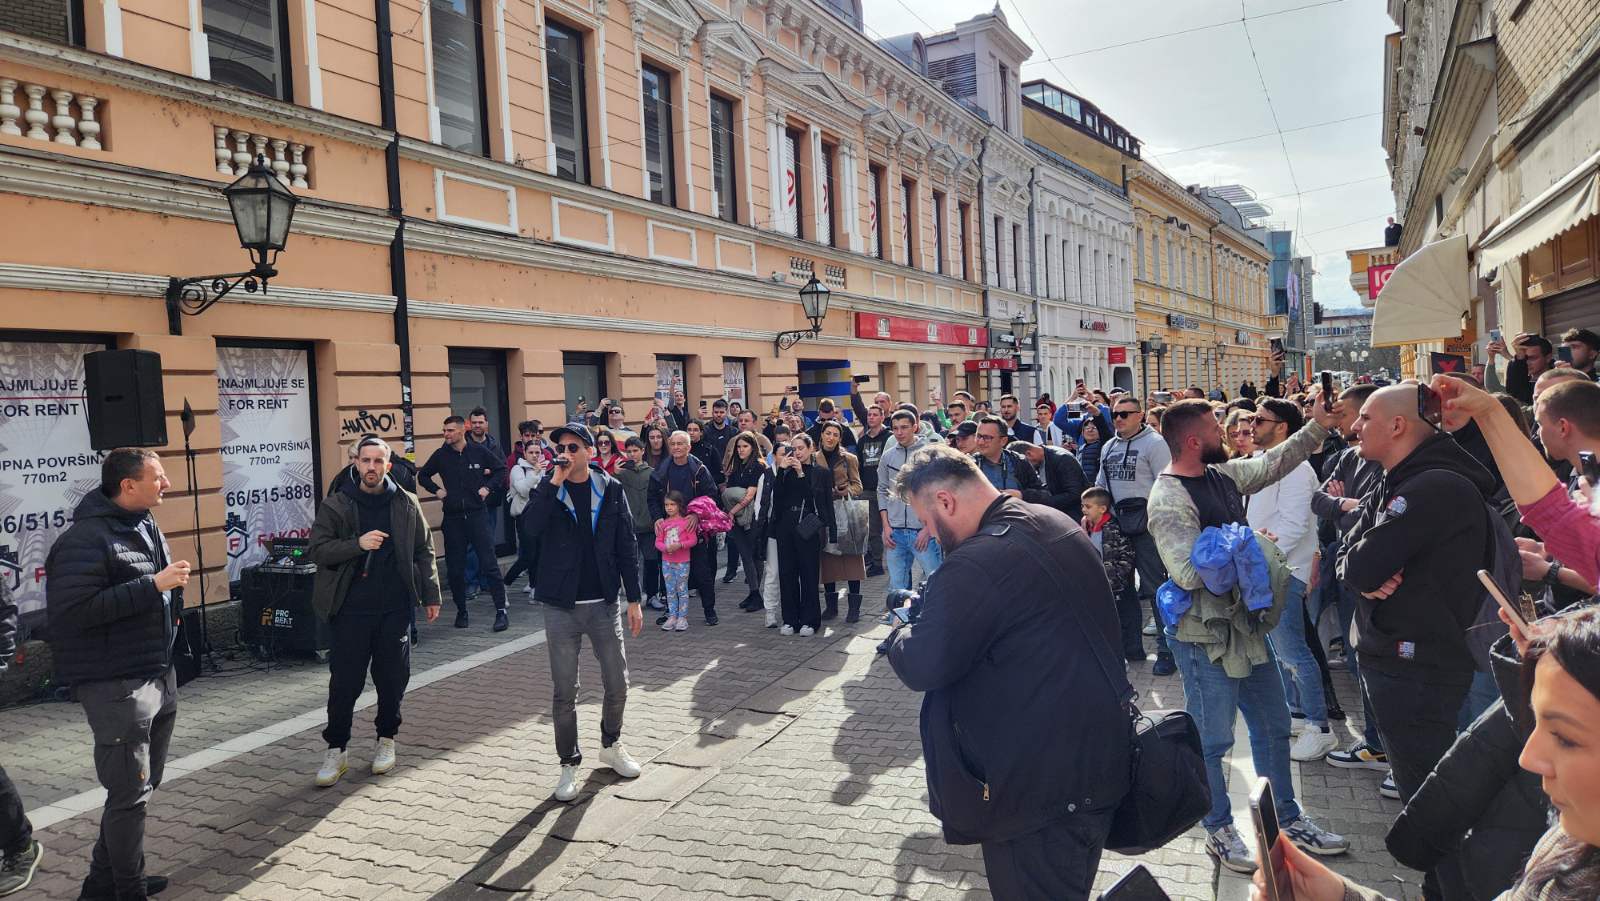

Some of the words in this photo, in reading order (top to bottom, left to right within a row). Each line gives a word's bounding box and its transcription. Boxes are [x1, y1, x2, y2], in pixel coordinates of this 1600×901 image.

[291, 379, 305, 389] SE
[0, 404, 30, 418] OR
[35, 403, 80, 416] RENT
[229, 399, 255, 411] FOR
[258, 399, 289, 410] RENT
[217, 444, 258, 456] KUPNA
[260, 440, 311, 453] POVRŠINA
[0, 459, 34, 471] PNA
[37, 453, 102, 469] POVRŠIN
[249, 455, 281, 466] 770m2
[22, 471, 68, 485] 770m2
[226, 484, 311, 507] 66/515-888
[0, 510, 73, 534] 6/515-
[274, 617, 293, 625] RENT
